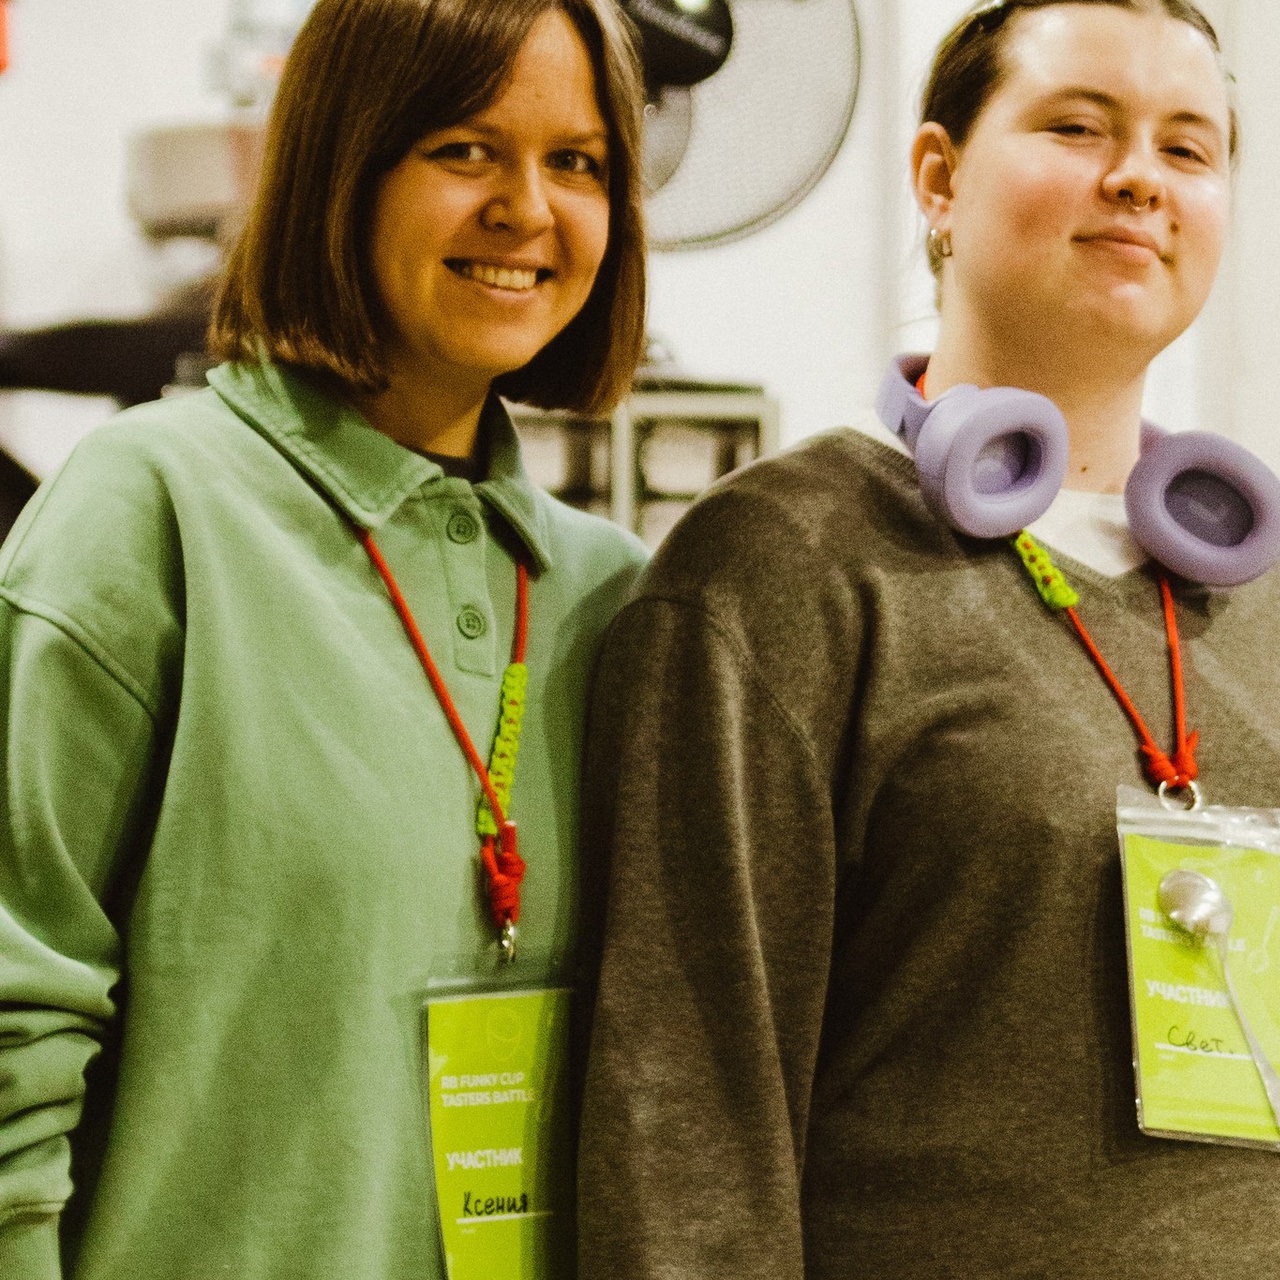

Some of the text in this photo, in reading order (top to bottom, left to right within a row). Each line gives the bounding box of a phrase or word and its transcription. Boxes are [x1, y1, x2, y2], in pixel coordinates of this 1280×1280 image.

[500, 1071, 525, 1085] CUP
[445, 1147, 523, 1172] УЧАСТНИК
[463, 1190, 529, 1217] Ксения
